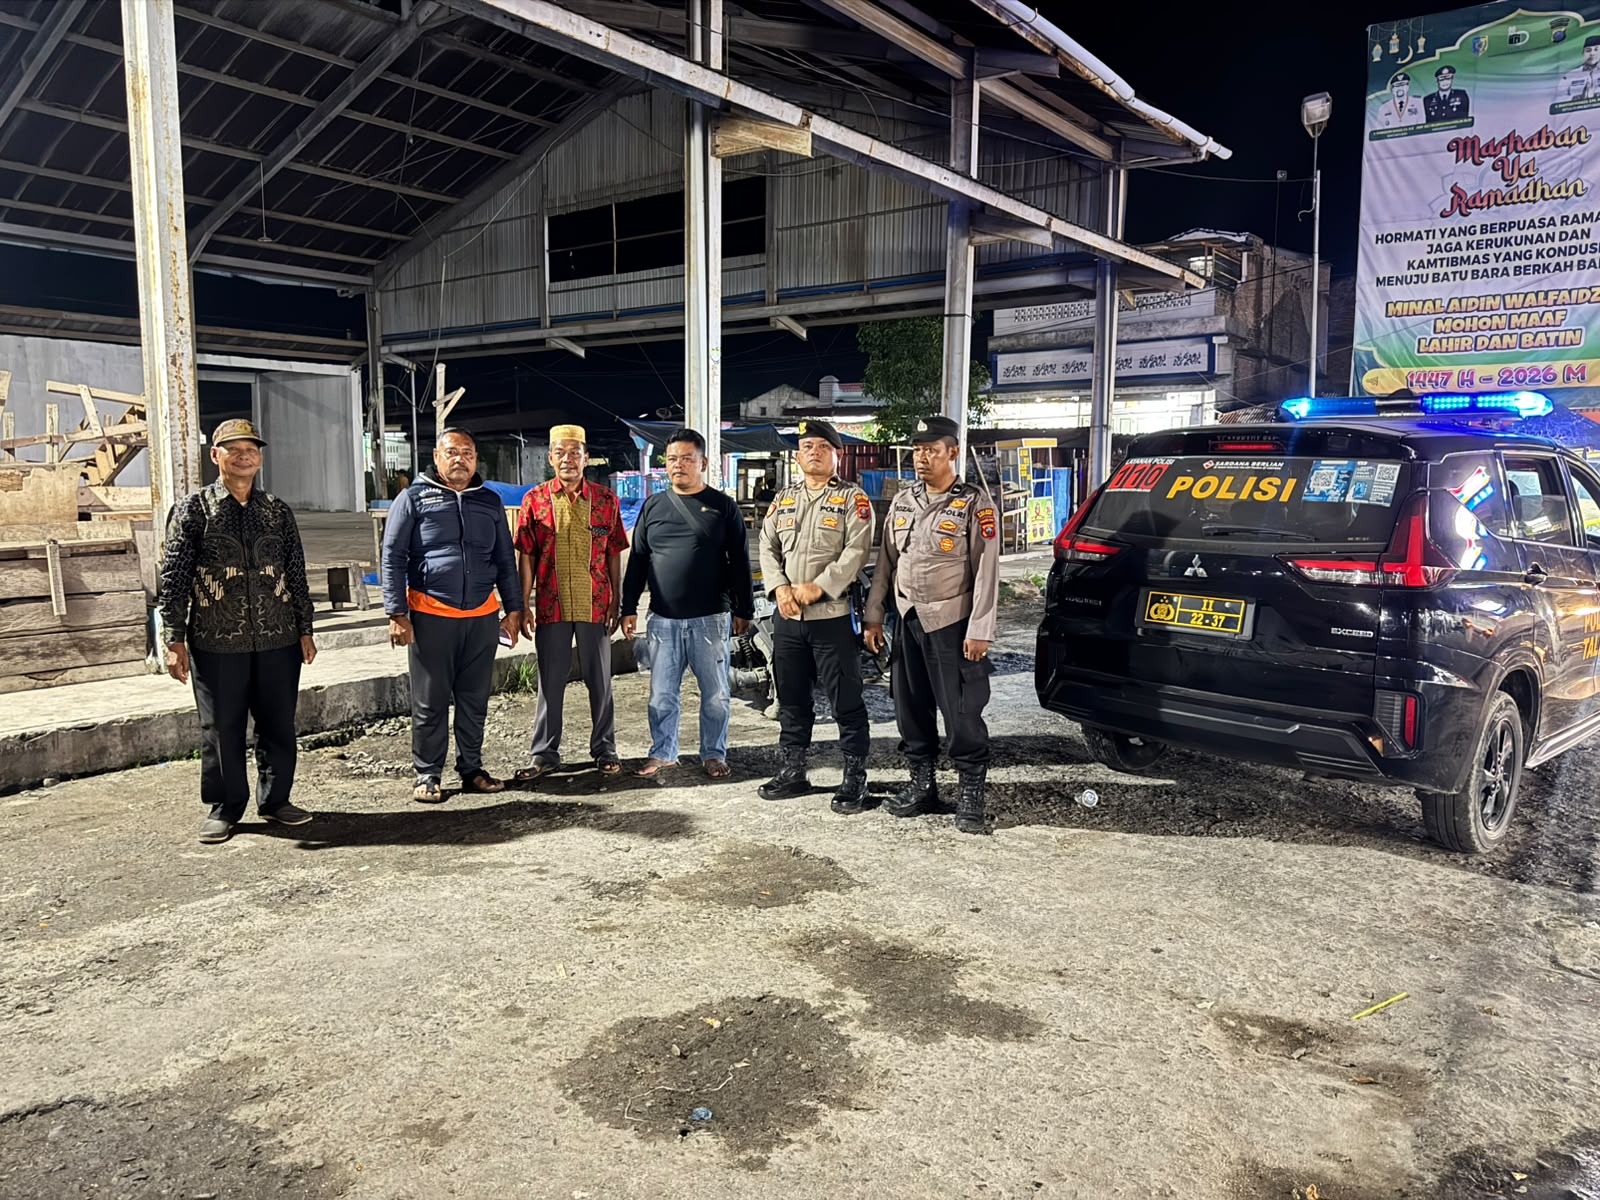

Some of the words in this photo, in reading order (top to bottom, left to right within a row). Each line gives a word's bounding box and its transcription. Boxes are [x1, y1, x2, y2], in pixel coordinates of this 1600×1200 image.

[1447, 124, 1592, 166] Marhaban
[1492, 154, 1539, 188] Ya
[1440, 177, 1588, 218] Ramadhan
[1375, 229, 1436, 244] HORMATI
[1438, 224, 1477, 239] YANG
[1480, 216, 1557, 235] BERPUASA
[1427, 242, 1463, 255] JAGA
[1466, 231, 1556, 251] KERUKUNAN
[1559, 228, 1591, 242] DAN
[1375, 273, 1429, 287] MENUJU
[1432, 269, 1468, 283] BATU
[1471, 266, 1510, 280] BARA
[1513, 261, 1574, 277] BERKAH
[1577, 257, 1600, 271] BA
[1407, 253, 1490, 271] KAMTIBMAS
[1493, 248, 1532, 264] YANG
[1386, 299, 1444, 317] MINAL
[1445, 294, 1500, 313] AIDIN
[1434, 314, 1507, 334] MOHON
[1510, 309, 1567, 329] MAAF
[1418, 335, 1473, 354] LAHIR
[1476, 332, 1518, 351] DAN
[1521, 329, 1583, 349] BATIN
[1406, 369, 1453, 389] 1447
[1458, 370, 1475, 388] H
[1498, 366, 1558, 387] 2026
[1563, 364, 1588, 383] M
[1113, 465, 1165, 488] 110
[1166, 475, 1297, 503] POLISI
[820, 505, 849, 515] POLRI
[940, 508, 967, 519] POLRI
[1331, 627, 1374, 638] EXCEED
